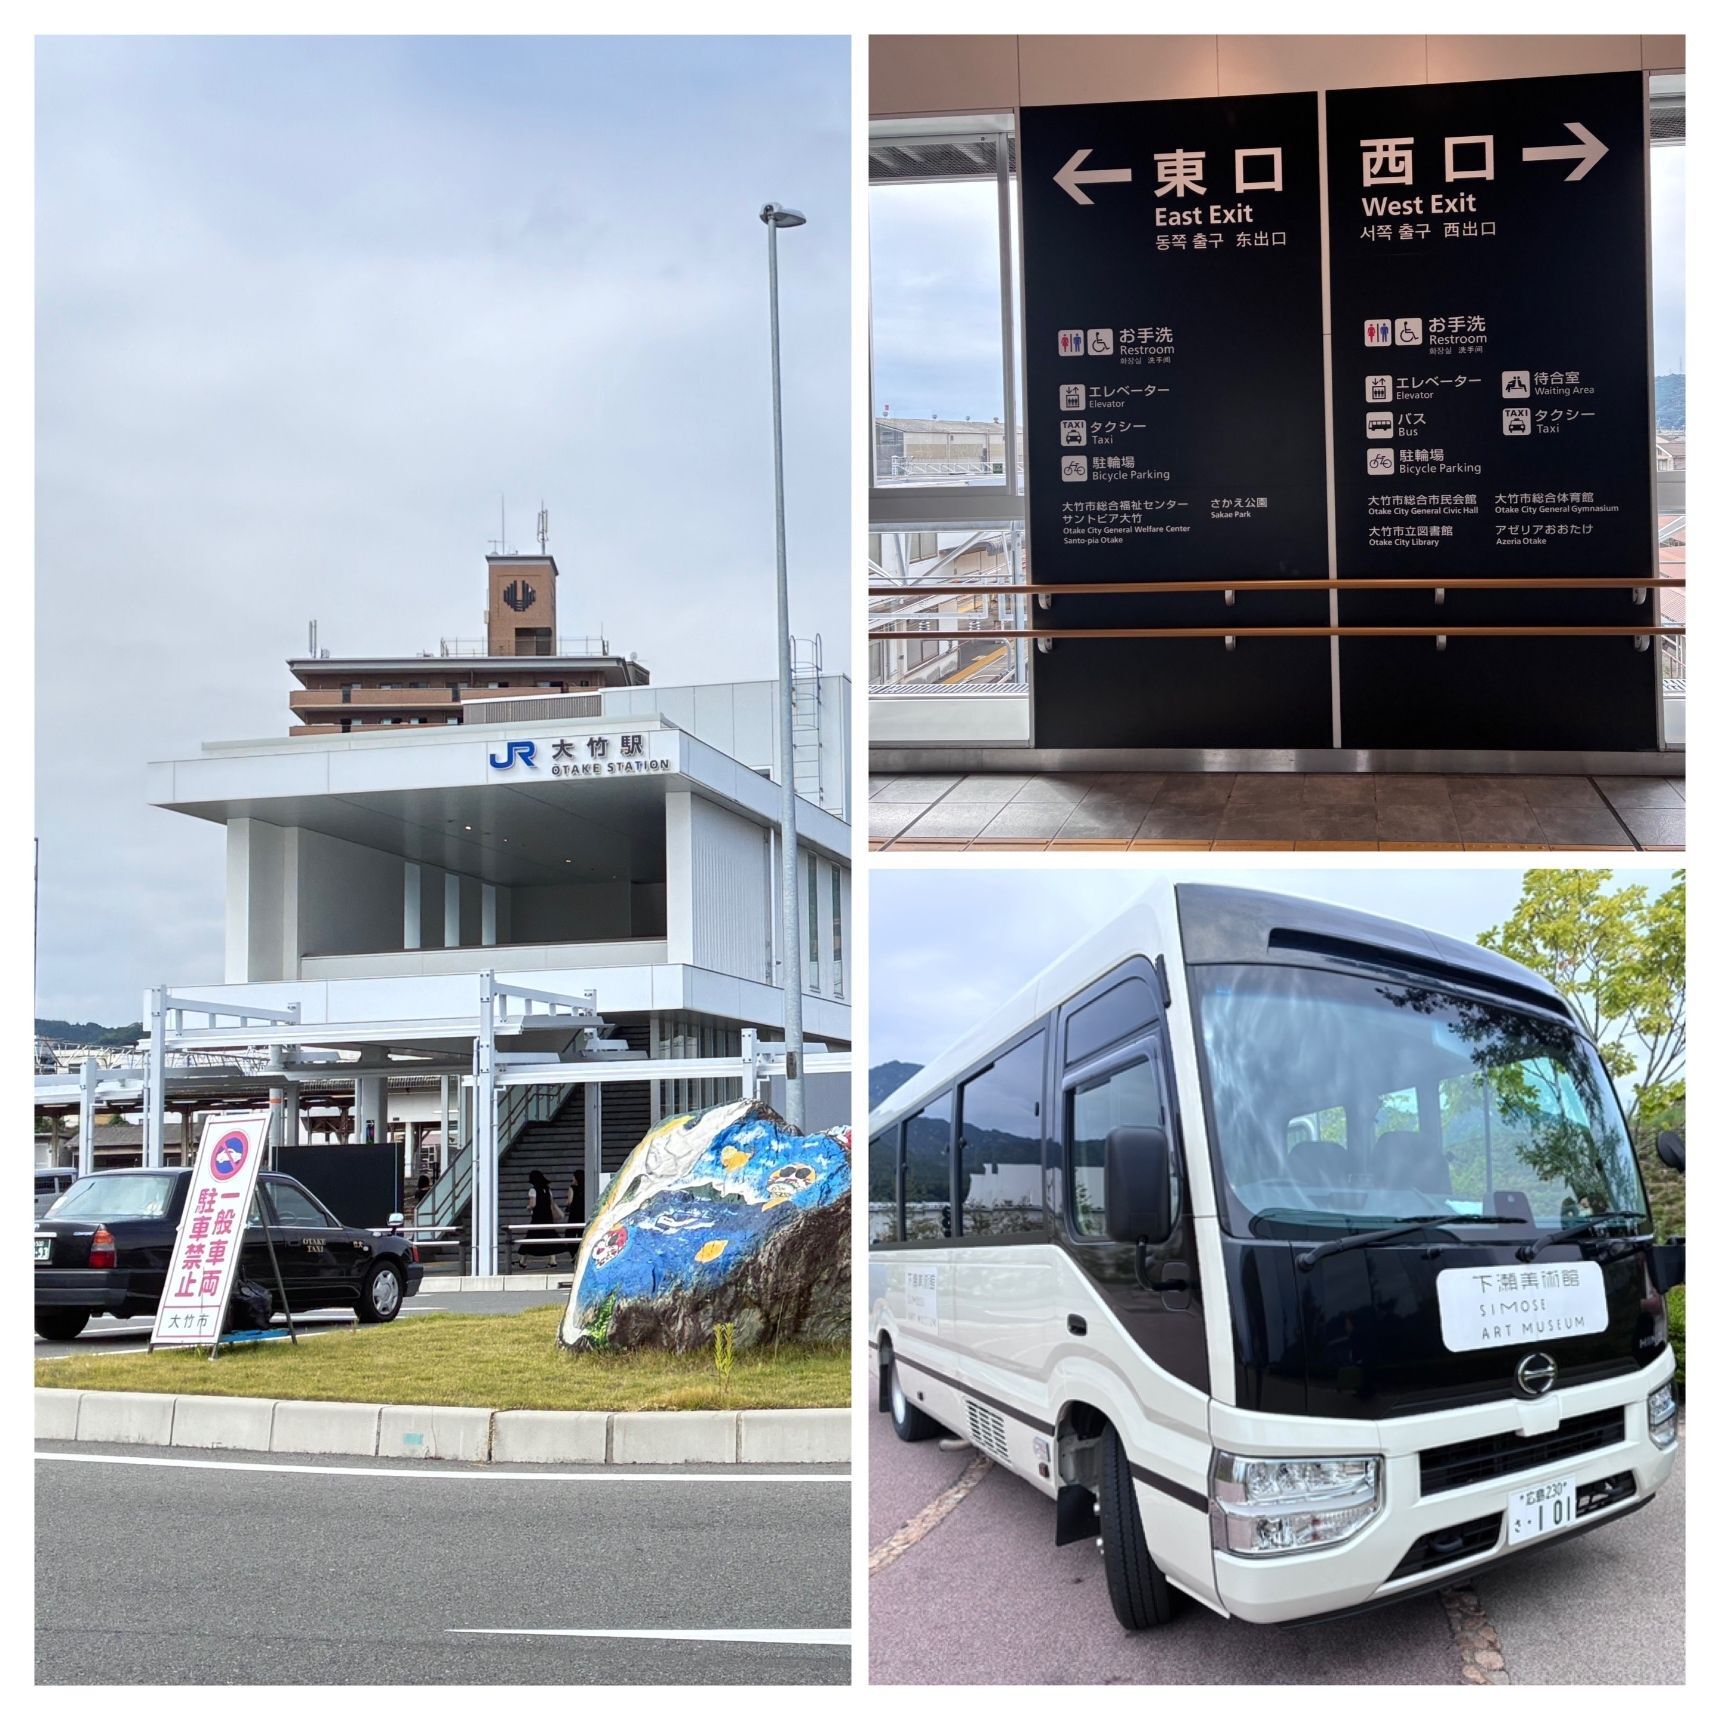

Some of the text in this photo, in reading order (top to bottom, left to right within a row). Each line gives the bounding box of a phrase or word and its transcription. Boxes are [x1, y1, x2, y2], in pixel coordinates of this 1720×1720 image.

[1360, 135, 1494, 187] 西口
[1154, 147, 1282, 197] 東口
[1362, 192, 1476, 216] West Exit
[1156, 203, 1253, 226] East Exit
[1360, 224, 1431, 241] 서쪽 출구
[1444, 221, 1495, 238] 西出口
[1156, 233, 1223, 250] 동쪽 출구
[1236, 231, 1285, 247] 东出口
[1429, 315, 1485, 332] お手洗
[1120, 327, 1173, 343] お手洗
[1430, 335, 1487, 344] Restroom
[1120, 346, 1174, 355] Restroom
[1397, 375, 1481, 388] エレベーター
[1534, 371, 1580, 385] 待合室
[1089, 385, 1169, 397] エレベーター
[1397, 391, 1434, 399] Elevator
[1535, 386, 1594, 396] Waiting Area
[1090, 400, 1125, 408] Elevator
[1398, 413, 1426, 424] バス
[1535, 409, 1595, 421] タクシー
[1062, 421, 1085, 429] TAXI
[1091, 421, 1146, 433] タクシー
[1537, 424, 1559, 433] Taxi
[1399, 428, 1418, 436] Bus
[1092, 435, 1113, 444] Taxi
[1400, 449, 1444, 462] 駐輪場
[1093, 456, 1135, 470] 駐輪場
[1400, 463, 1481, 475] Bicycle Parking
[1093, 470, 1169, 482] Bicycle Parking
[1394, 508, 1409, 516] City
[1521, 506, 1537, 514] City
[1571, 505, 1619, 513] Gymnasium
[1087, 527, 1102, 535] City
[1064, 537, 1099, 545] Santo-pia
[1395, 539, 1410, 547] City
[1412, 539, 1439, 547] Library
[551, 734, 643, 761] 大竹駅
[489, 740, 537, 769] JR
[607, 759, 671, 774] STATION
[174, 1187, 217, 1298] 駐車禁止
[198, 1192, 240, 1297] 一般車両
[1479, 1298, 1547, 1318] SIMOSE
[167, 1313, 210, 1330] 大竹市
[1481, 1316, 1586, 1341] ART MUSEUM
